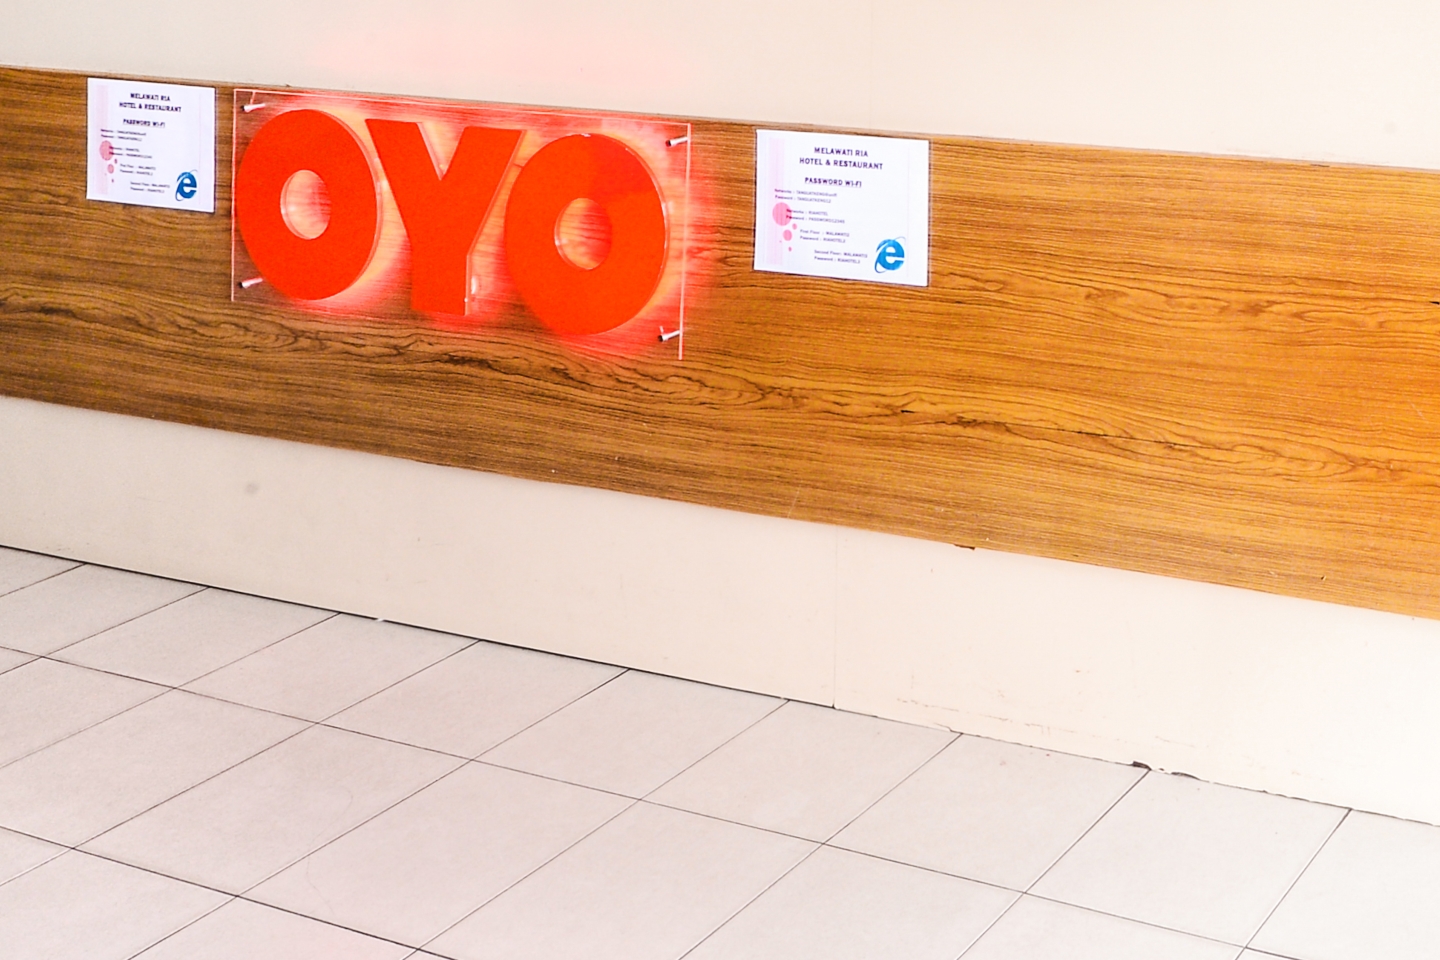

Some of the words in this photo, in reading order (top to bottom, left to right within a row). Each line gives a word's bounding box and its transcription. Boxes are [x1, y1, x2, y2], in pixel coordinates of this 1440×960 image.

[130, 93, 159, 101] MELAWATI
[144, 104, 182, 112] RESTAURANT
[814, 147, 853, 157] MELAWATI
[799, 157, 823, 166] HOTEL
[833, 160, 883, 170] RESTAURANT
[804, 177, 843, 186] PASSWORD
[845, 180, 862, 188] WI-FI
[236, 109, 670, 335] OYO
